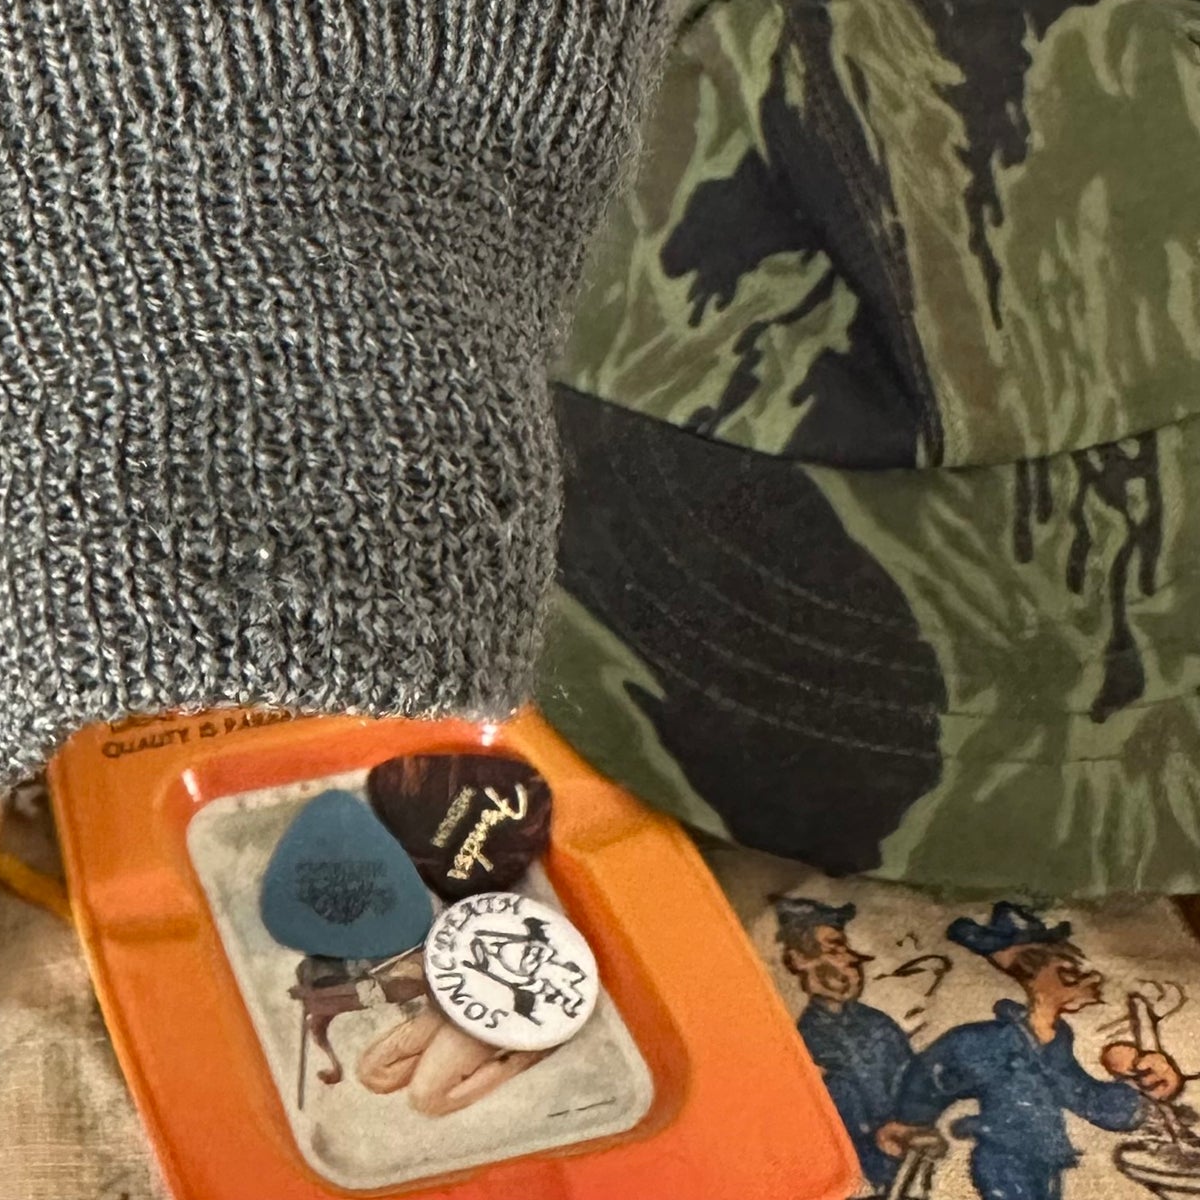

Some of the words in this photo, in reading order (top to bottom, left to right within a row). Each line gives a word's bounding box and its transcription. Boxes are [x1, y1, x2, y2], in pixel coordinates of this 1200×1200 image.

[102, 728, 189, 758] QUALITY
[447, 782, 528, 880] Fender
[430, 952, 509, 1028] SONIC
